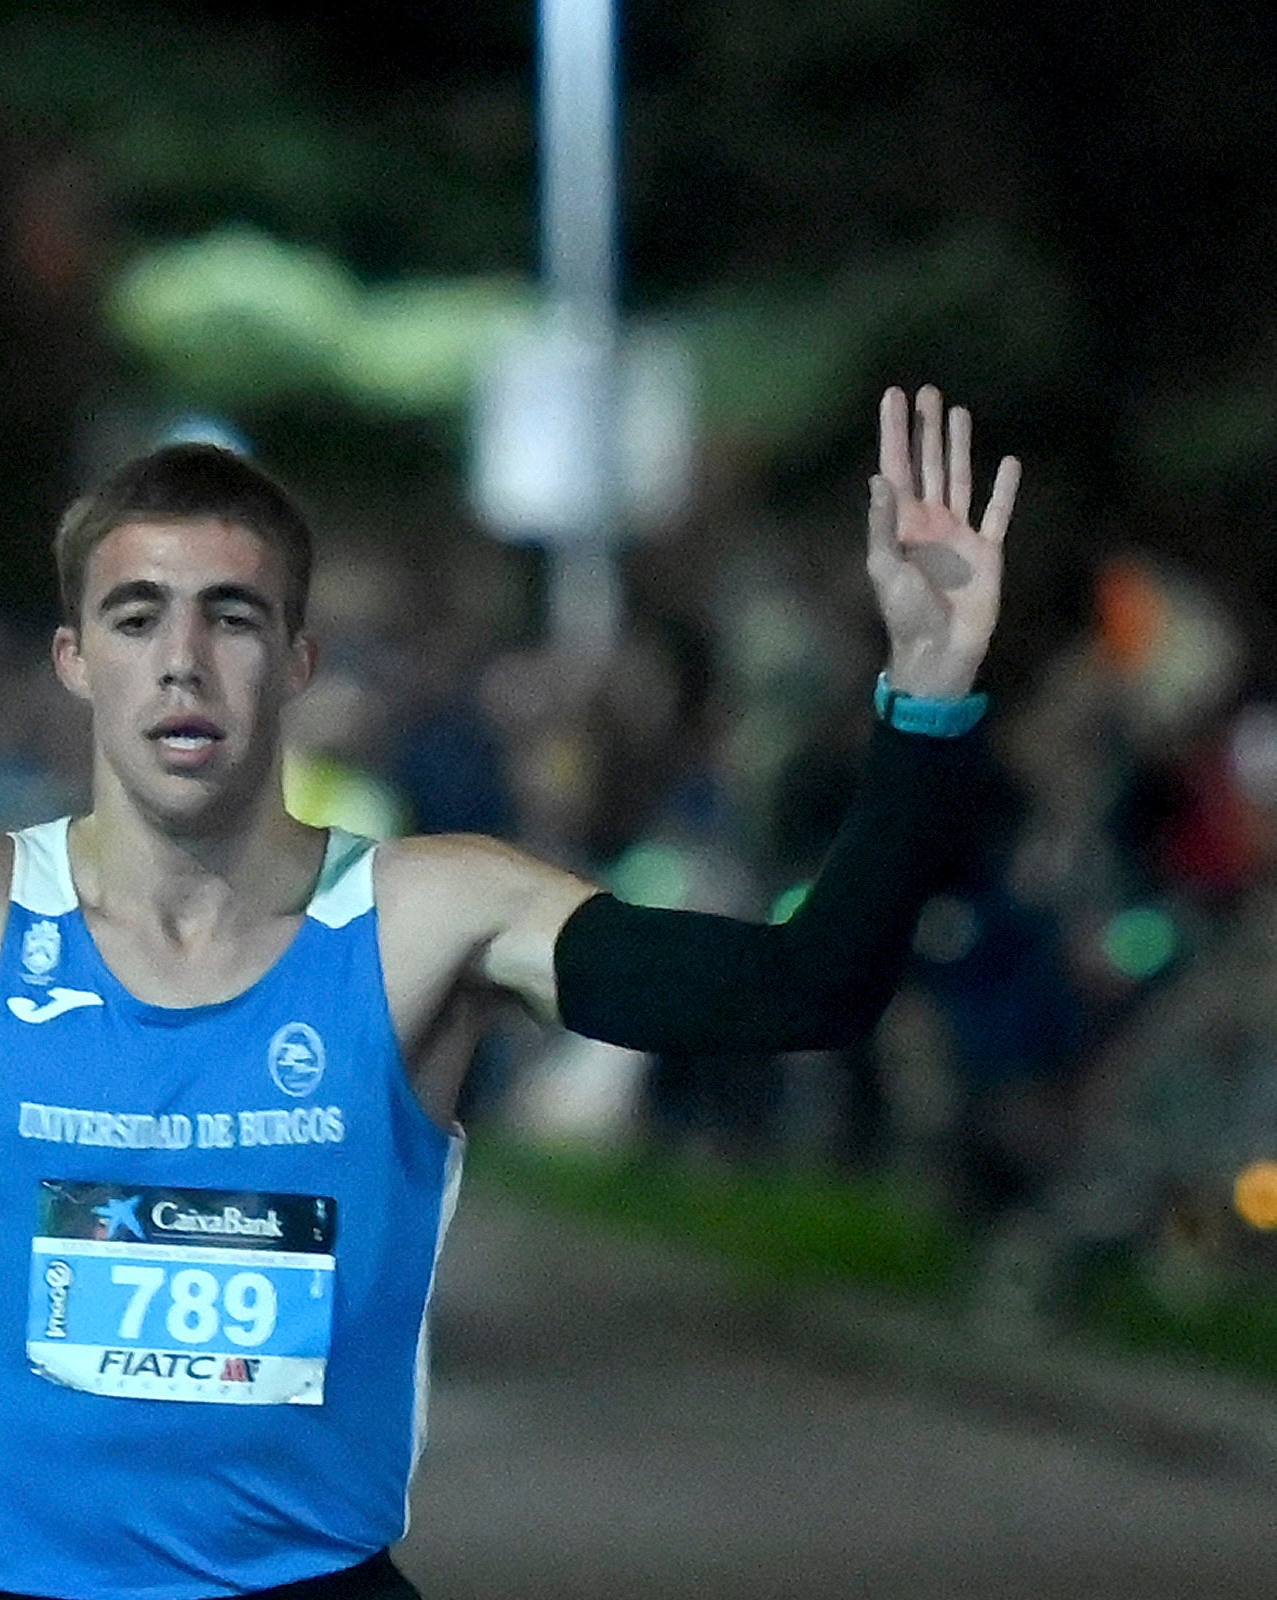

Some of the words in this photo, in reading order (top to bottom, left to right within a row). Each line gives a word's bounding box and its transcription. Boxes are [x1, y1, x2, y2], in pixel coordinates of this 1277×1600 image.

[198, 1114, 235, 1148] DE
[238, 1105, 345, 1147] BURGOS
[151, 1201, 283, 1237] CaixaBank
[112, 1265, 277, 1347] 789
[99, 1350, 216, 1380] FIATC
